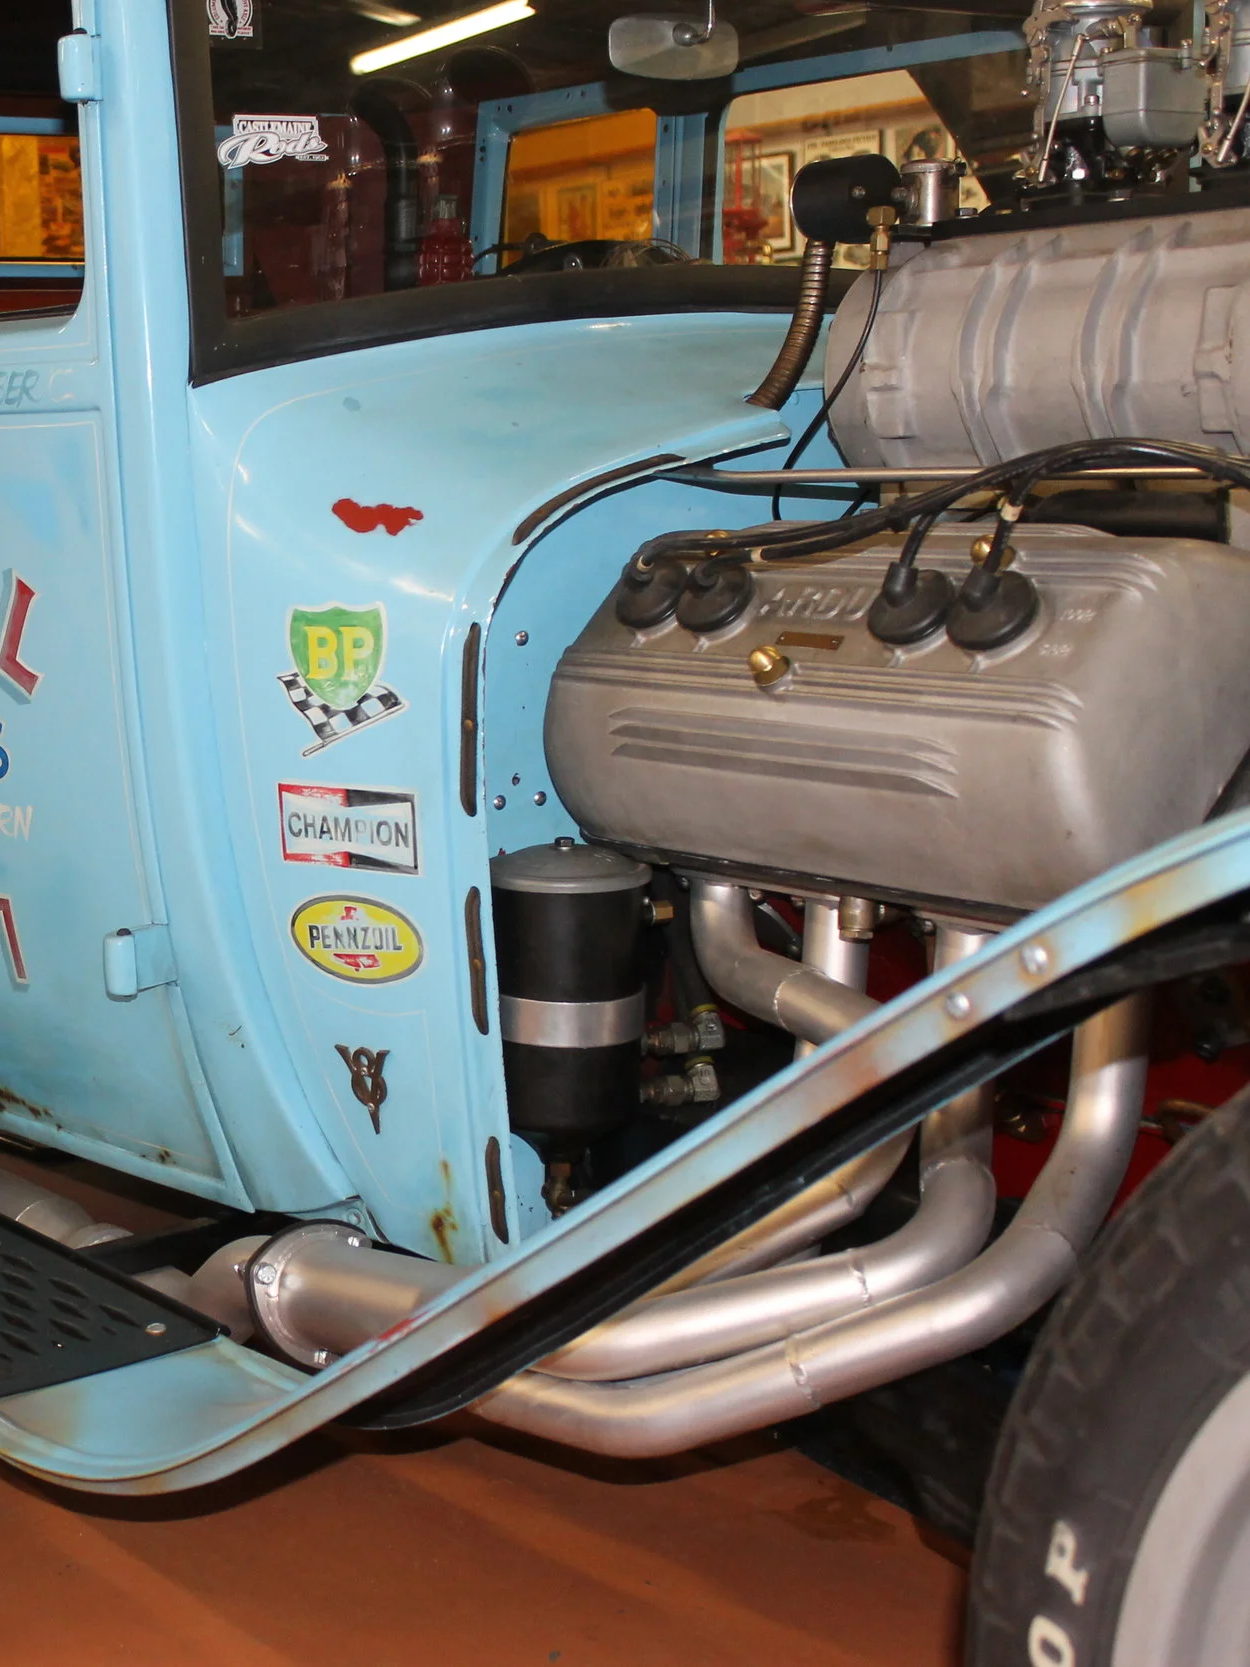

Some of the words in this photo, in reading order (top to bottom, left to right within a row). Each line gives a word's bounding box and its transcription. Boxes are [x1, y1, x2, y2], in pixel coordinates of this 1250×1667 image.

[238, 120, 314, 137] CASTLEMAINE
[217, 131, 328, 169] Rods
[757, 587, 882, 620] ARDU
[303, 625, 375, 681] BP
[287, 811, 410, 848] CHAMPION
[308, 924, 403, 951] PENNZOIL
